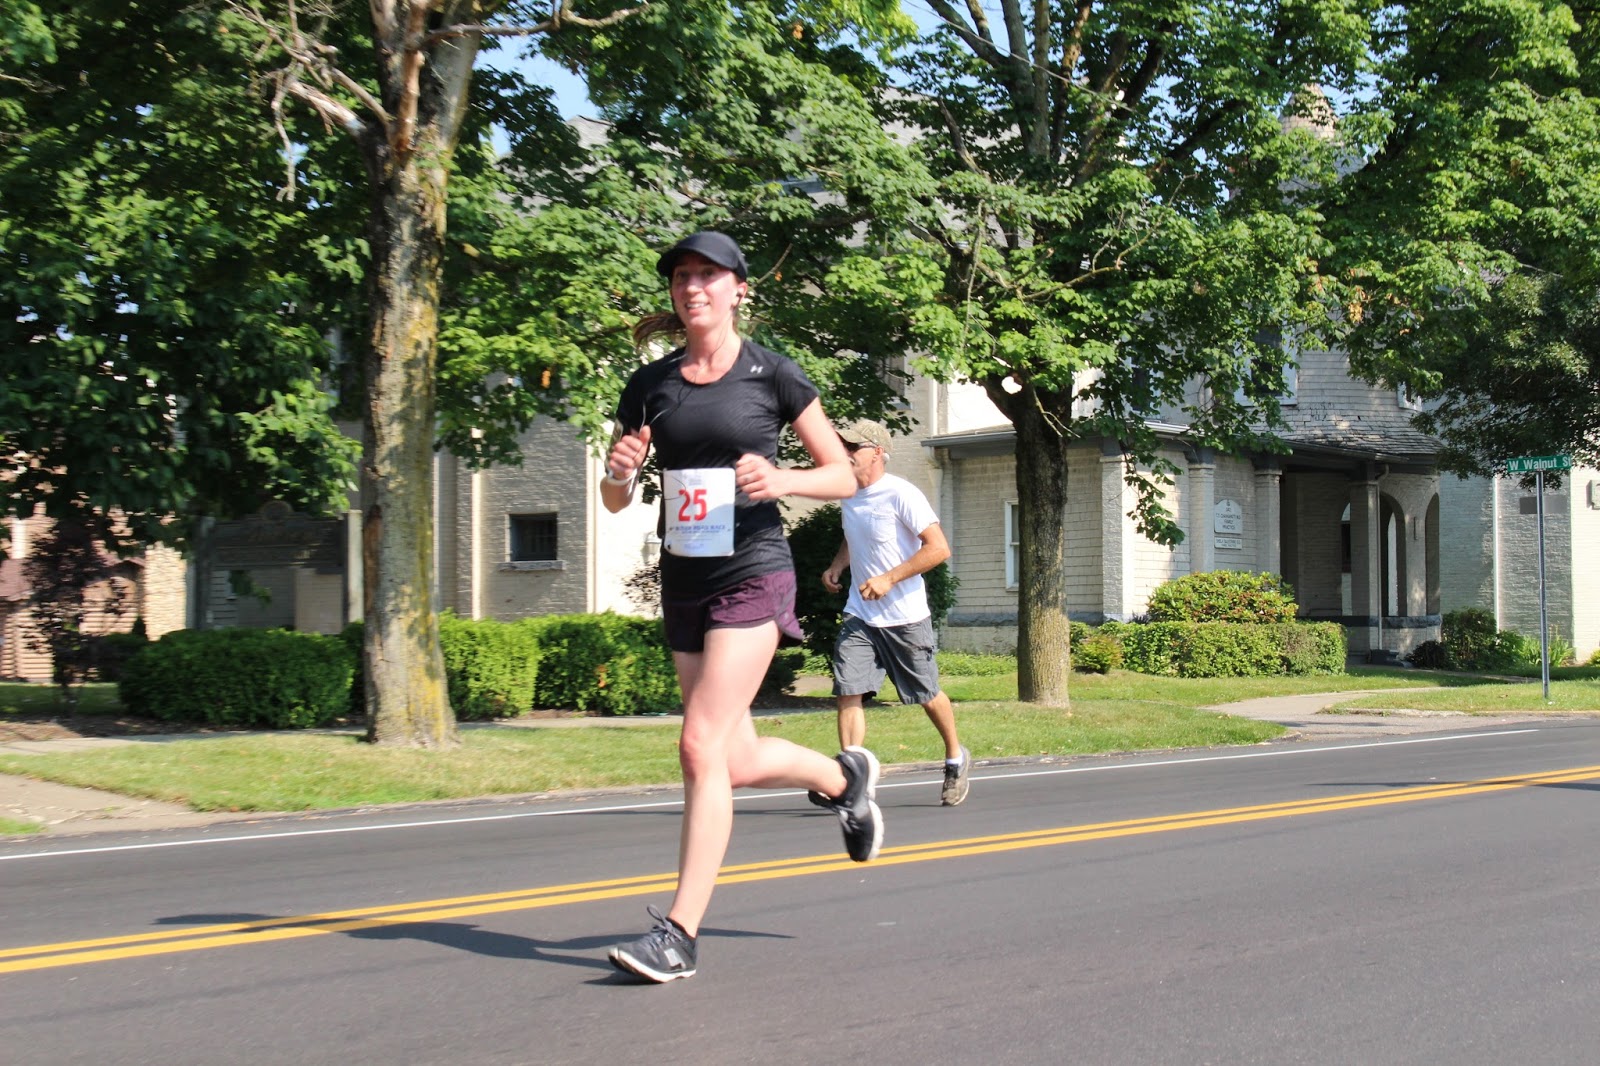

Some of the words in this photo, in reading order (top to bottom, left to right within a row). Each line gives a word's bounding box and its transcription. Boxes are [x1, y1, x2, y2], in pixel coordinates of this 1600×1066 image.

[1509, 460, 1519, 471] W
[1523, 458, 1558, 470] Walnut
[1562, 456, 1572, 467] St
[678, 488, 707, 522] 25
